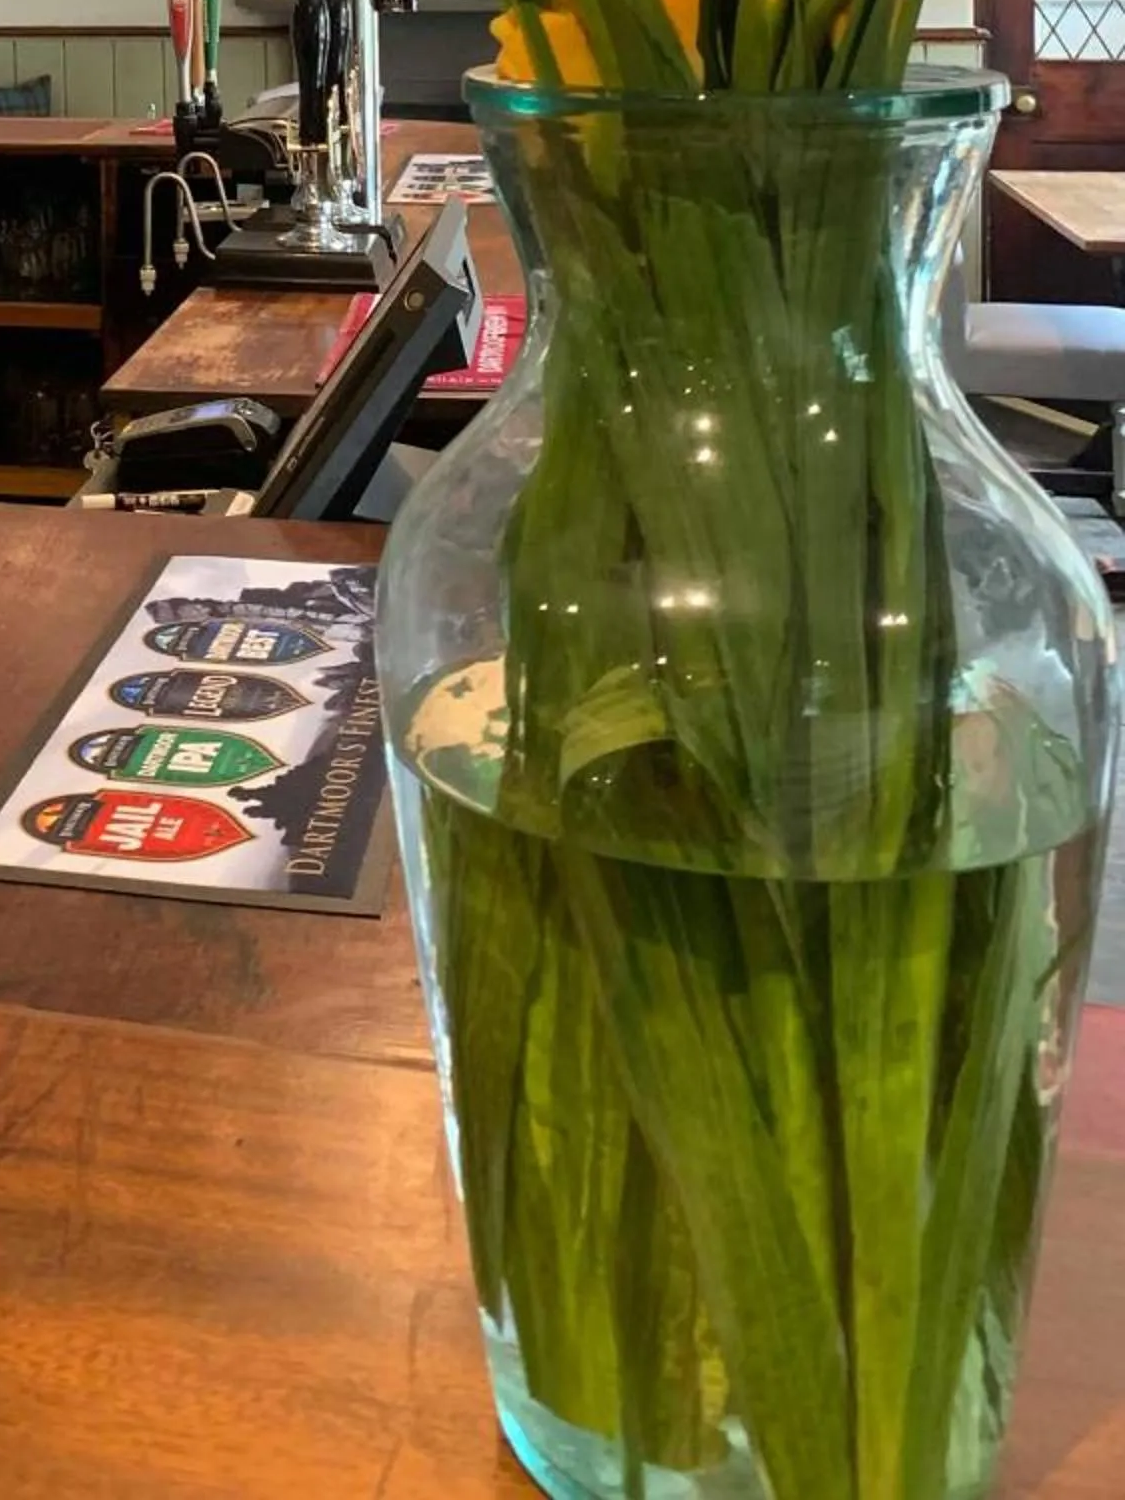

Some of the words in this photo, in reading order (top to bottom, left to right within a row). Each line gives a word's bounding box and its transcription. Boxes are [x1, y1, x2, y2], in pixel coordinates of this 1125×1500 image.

[236, 628, 279, 660] BEST
[183, 674, 237, 717] LEGEND
[167, 741, 223, 773] IPA
[98, 802, 163, 851] JAIL
[154, 816, 184, 841] ALE
